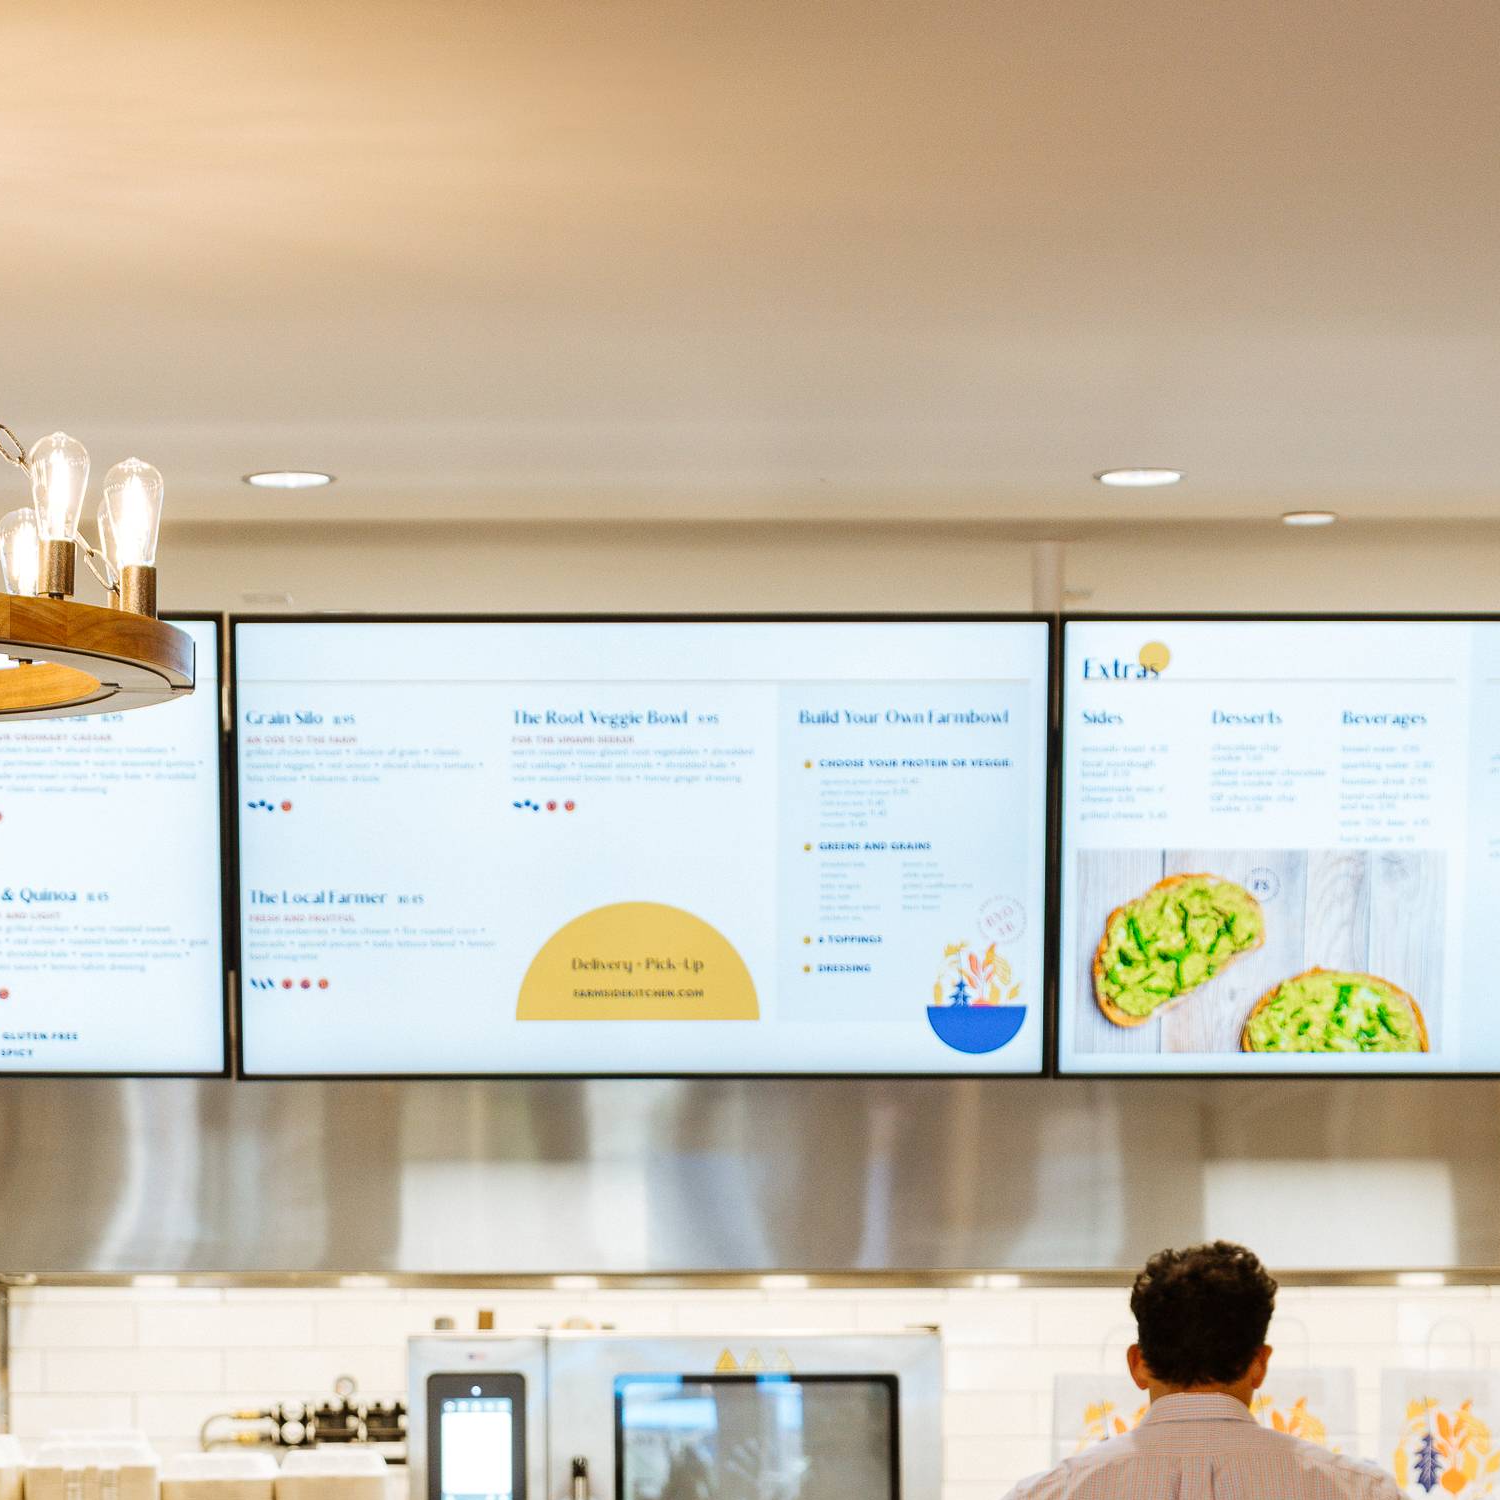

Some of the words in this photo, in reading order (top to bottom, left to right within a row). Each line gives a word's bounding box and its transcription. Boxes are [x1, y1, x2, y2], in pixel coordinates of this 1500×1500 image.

[1083, 657, 1160, 680] Extras
[244, 710, 292, 727] Grain
[294, 710, 324, 726] Silo
[513, 709, 542, 726] The
[545, 709, 584, 725] Root
[589, 710, 641, 728] Veggie
[647, 709, 688, 726] Bowl
[798, 709, 840, 725] Build
[844, 709, 878, 725] Your
[884, 709, 925, 724] Own
[927, 709, 1009, 725] Farmbowl
[1081, 710, 1124, 725] Sides
[1211, 709, 1283, 725] Desserts
[1342, 710, 1428, 727] Beverages
[901, 758, 949, 769] PROTEIN
[951, 758, 968, 768] OR
[819, 841, 859, 851] GREENS
[864, 841, 885, 851] AND
[0, 888, 15, 904] &
[19, 888, 78, 905] Quinoa
[249, 889, 277, 905] The
[281, 889, 325, 905] Local
[328, 889, 388, 905] Farmer
[828, 935, 883, 945] TOPPINGS
[572, 957, 632, 974] Delivery
